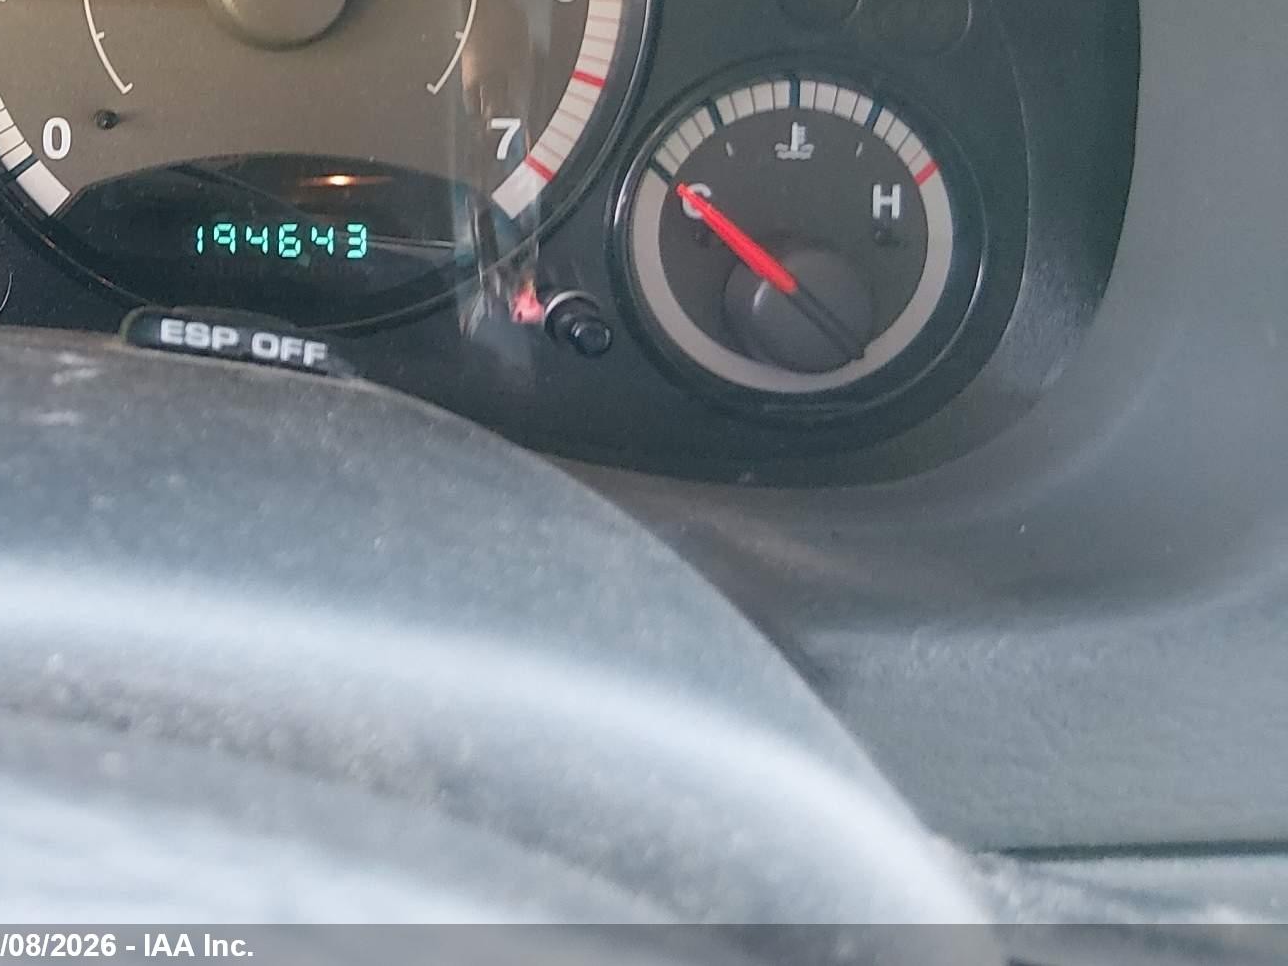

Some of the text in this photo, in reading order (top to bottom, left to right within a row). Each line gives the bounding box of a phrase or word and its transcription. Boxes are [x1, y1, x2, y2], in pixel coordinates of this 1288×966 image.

[41, 117, 72, 161] 0
[490, 118, 521, 160] 7
[871, 183, 901, 220] H
[196, 223, 367, 259] 194643
[159, 317, 329, 368] ESP OFF
